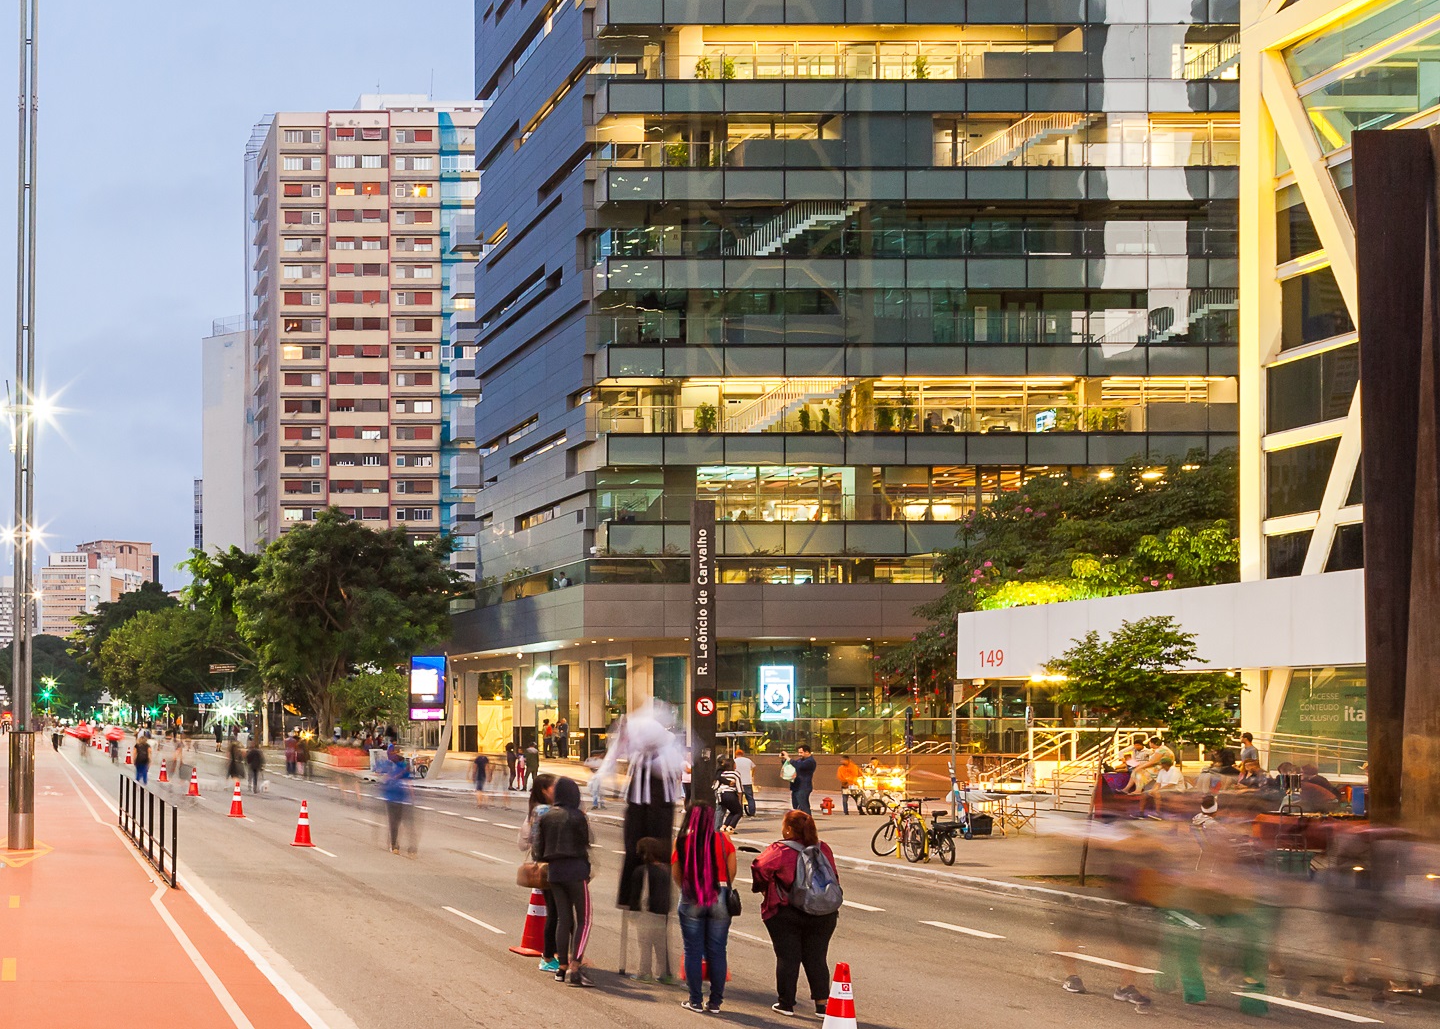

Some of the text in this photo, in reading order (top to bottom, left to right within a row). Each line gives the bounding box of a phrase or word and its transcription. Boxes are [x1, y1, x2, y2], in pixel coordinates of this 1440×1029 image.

[696, 529, 708, 675] R. Leôncio de Carvalho
[979, 649, 1004, 667] 149
[1299, 714, 1340, 722] EXCLUSIVO
